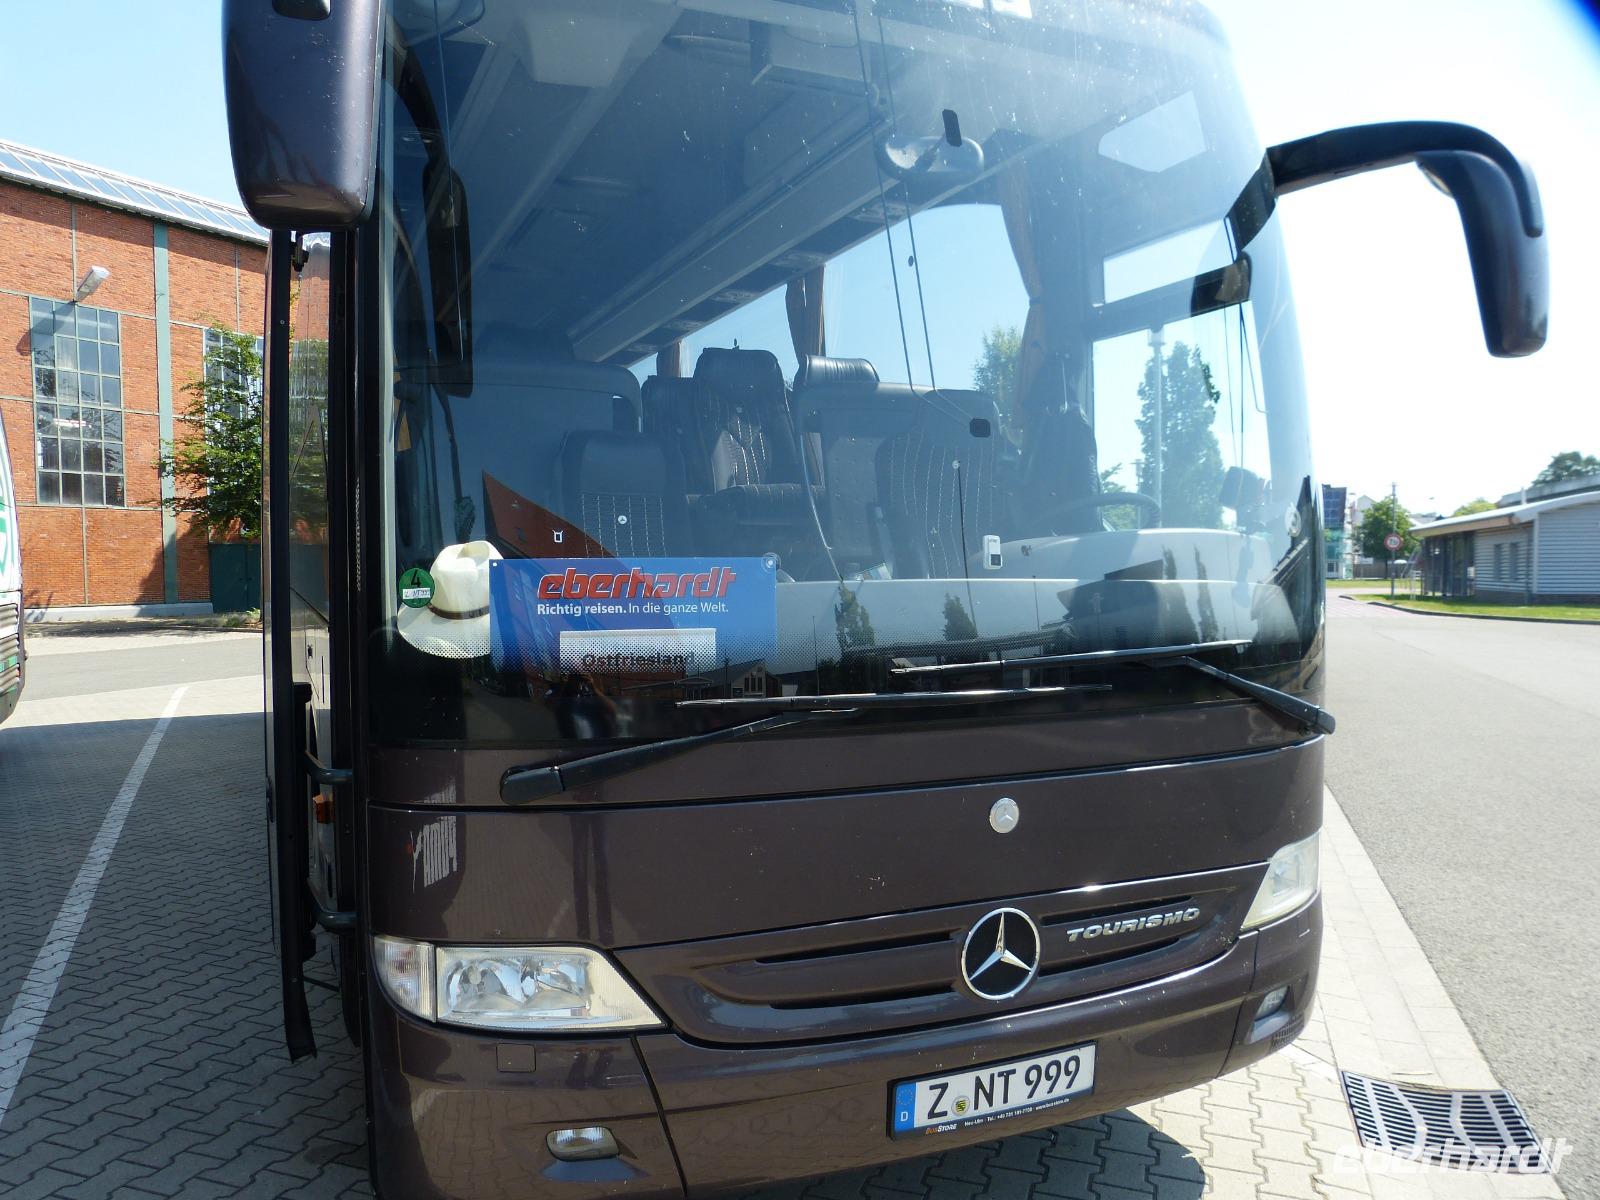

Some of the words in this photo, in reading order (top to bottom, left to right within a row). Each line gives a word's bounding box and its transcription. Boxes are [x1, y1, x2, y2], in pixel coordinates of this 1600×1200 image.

[411, 569, 422, 588] 4
[537, 567, 737, 599] eberhardt
[537, 603, 582, 617] Richtig
[585, 603, 627, 615] reisen.
[629, 602, 640, 613] In
[643, 601, 661, 614] die
[663, 604, 698, 616] ganze
[700, 601, 729, 613] Welt.
[582, 651, 695, 668] Ostfriesland
[1066, 907, 1200, 942] TOURISMO
[927, 1081, 949, 1120] Z
[974, 1068, 1016, 1111] NT
[1024, 1055, 1081, 1100] 999
[900, 1111, 909, 1122] D
